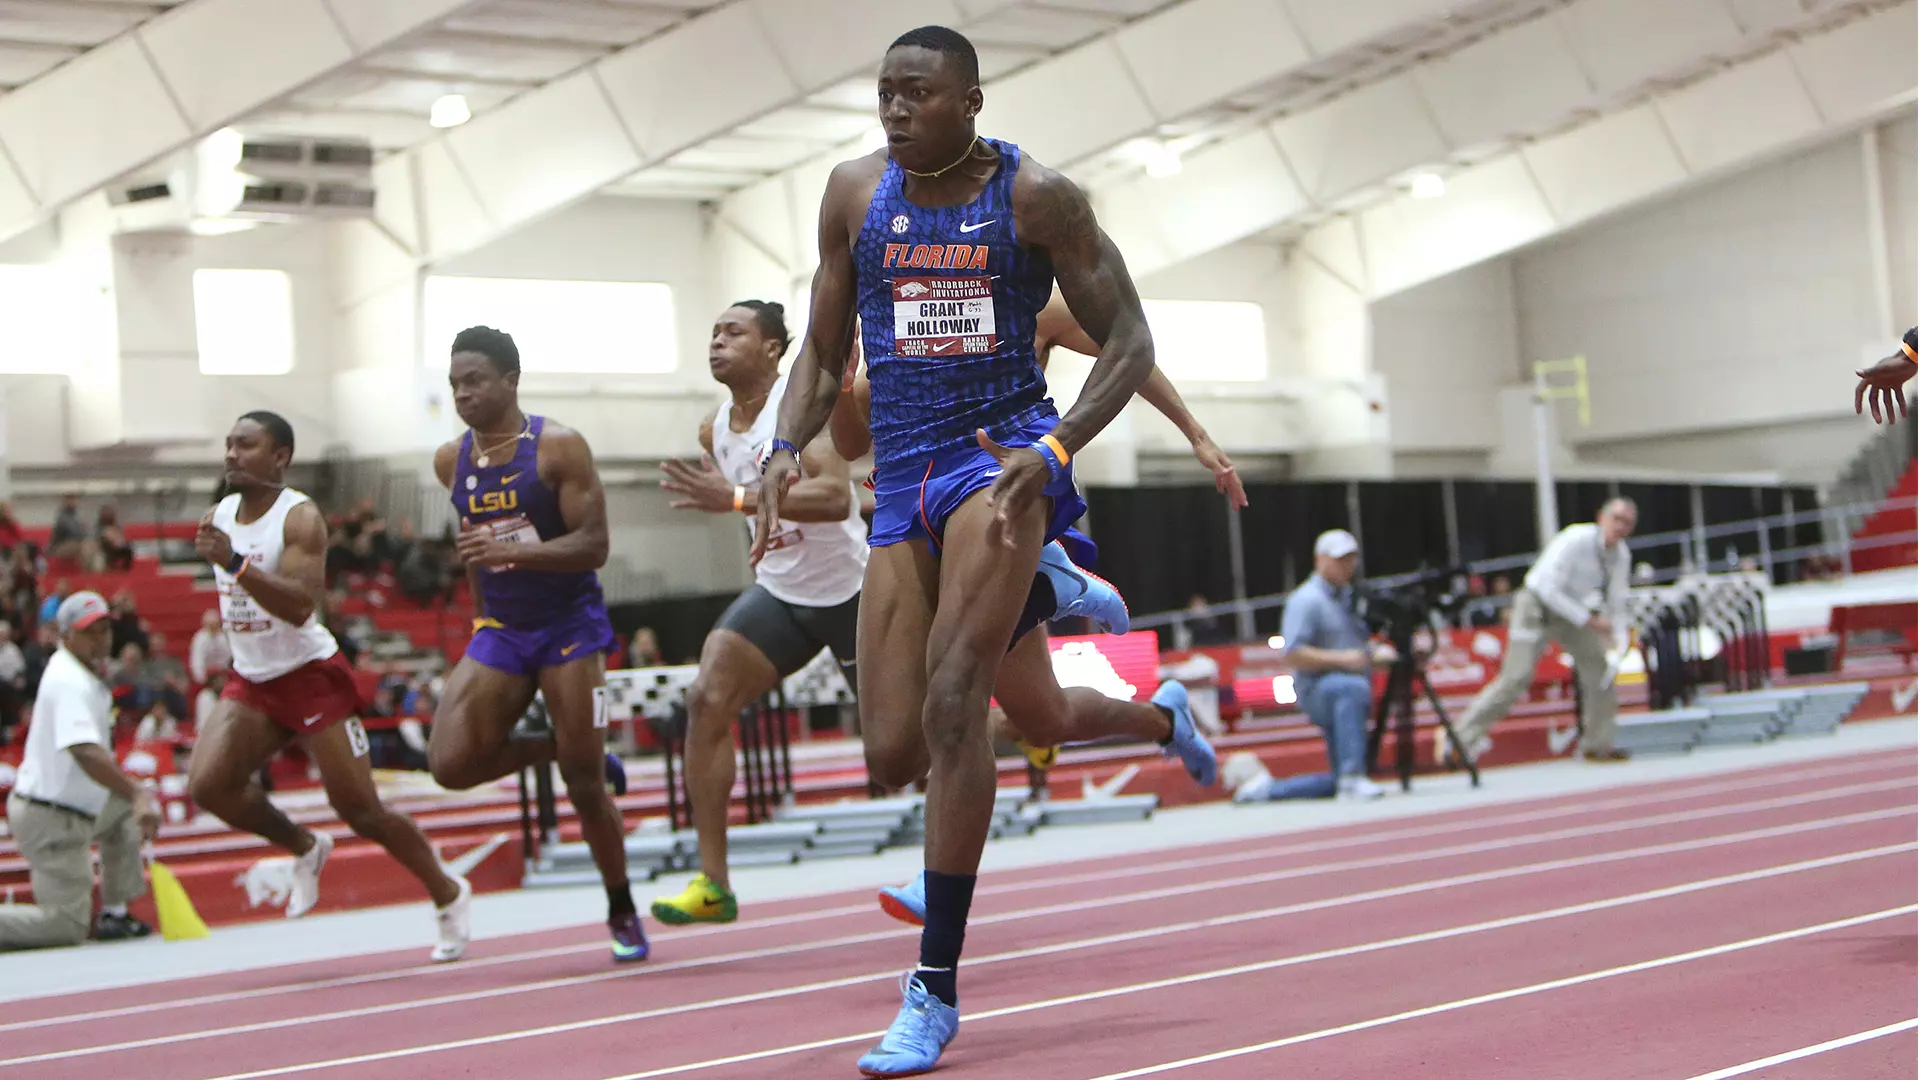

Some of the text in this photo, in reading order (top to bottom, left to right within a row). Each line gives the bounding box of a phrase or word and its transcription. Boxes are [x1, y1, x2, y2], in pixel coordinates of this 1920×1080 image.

[892, 215, 909, 233] SEC
[883, 244, 989, 269] FLORIDA
[931, 280, 982, 289] RAZORBACK
[932, 287, 990, 298] INVITATIONAL
[920, 302, 964, 317] GRANT
[907, 318, 980, 336] HOLLOWAY
[468, 490, 518, 514] LSU
